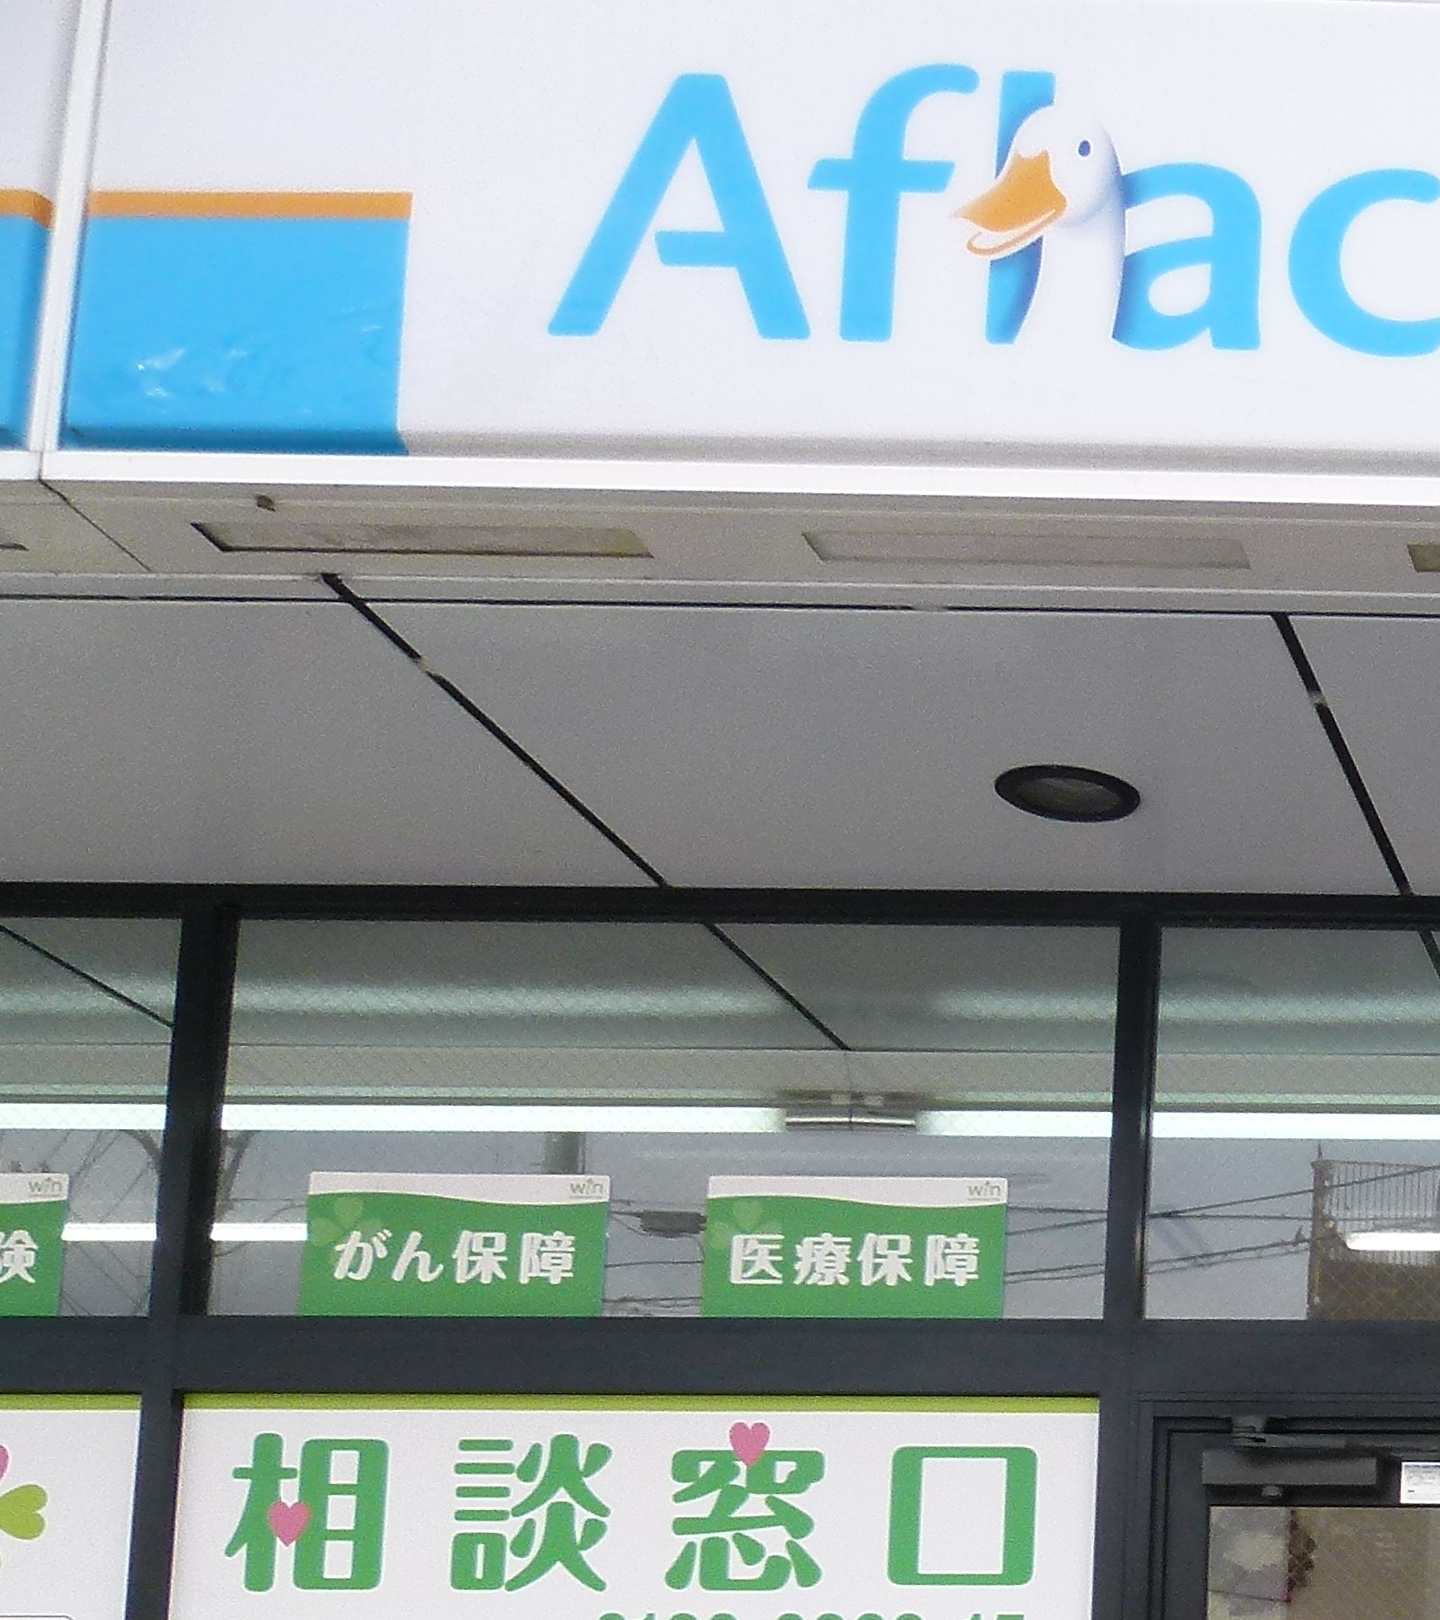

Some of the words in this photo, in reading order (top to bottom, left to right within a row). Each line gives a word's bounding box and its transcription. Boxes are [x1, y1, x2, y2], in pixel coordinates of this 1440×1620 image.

[333, 1229, 577, 1284] がん保障
[729, 1233, 981, 1287] 医療保障
[224, 1430, 1038, 1594] 相談窓口
